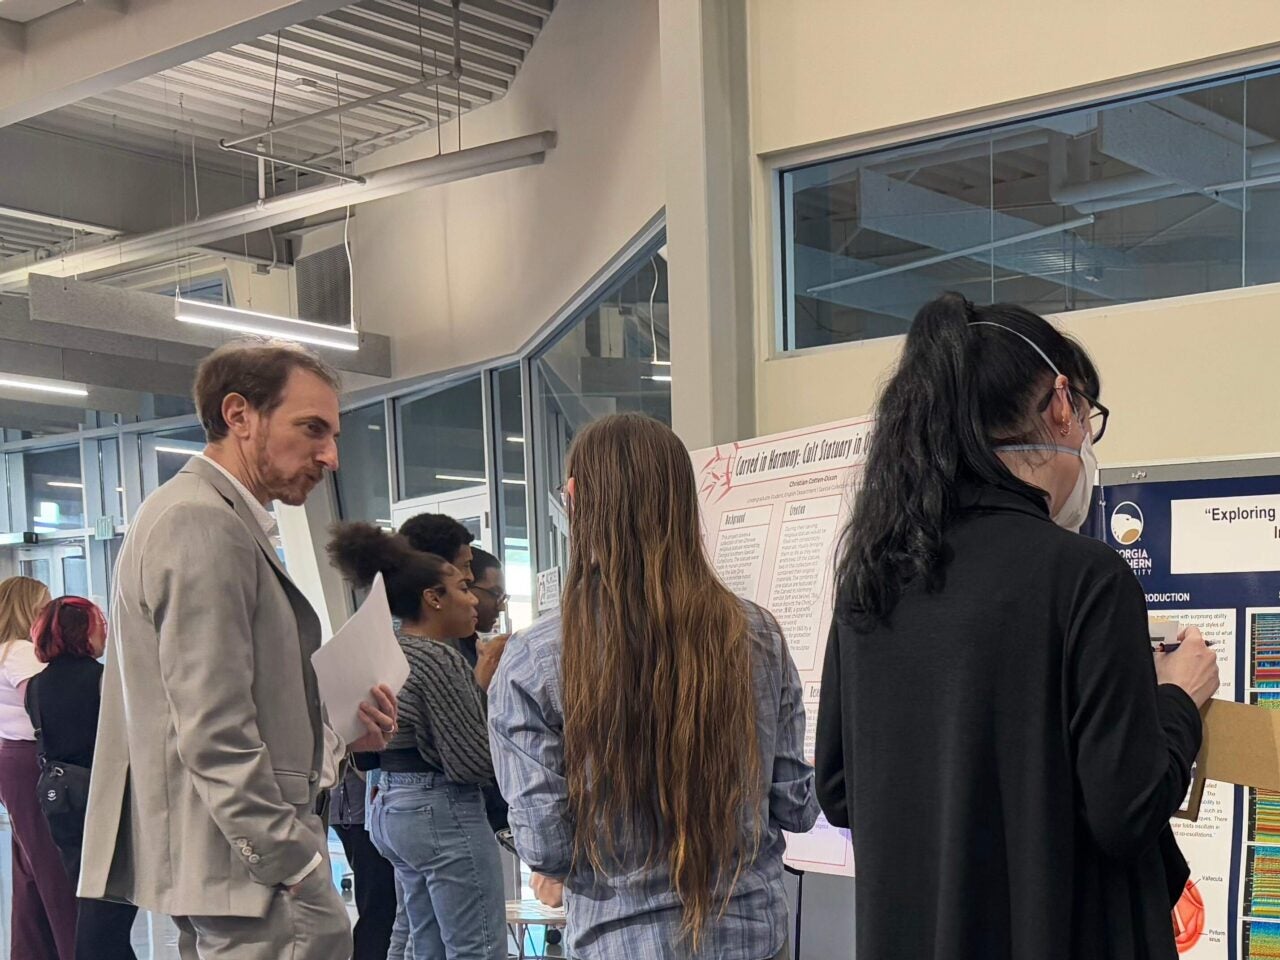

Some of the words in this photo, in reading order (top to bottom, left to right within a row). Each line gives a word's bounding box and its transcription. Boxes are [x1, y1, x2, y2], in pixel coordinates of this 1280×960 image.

[736, 452, 760, 476] Carved
[759, 452, 767, 472] in
[768, 447, 800, 472] Harmony:
[803, 442, 818, 464] Cult
[819, 438, 853, 461] Statuary
[853, 433, 862, 456] in
[1205, 505, 1276, 523] “Exploring
[1119, 549, 1148, 558] ORGIA
[1144, 592, 1190, 602] RODUCTION
